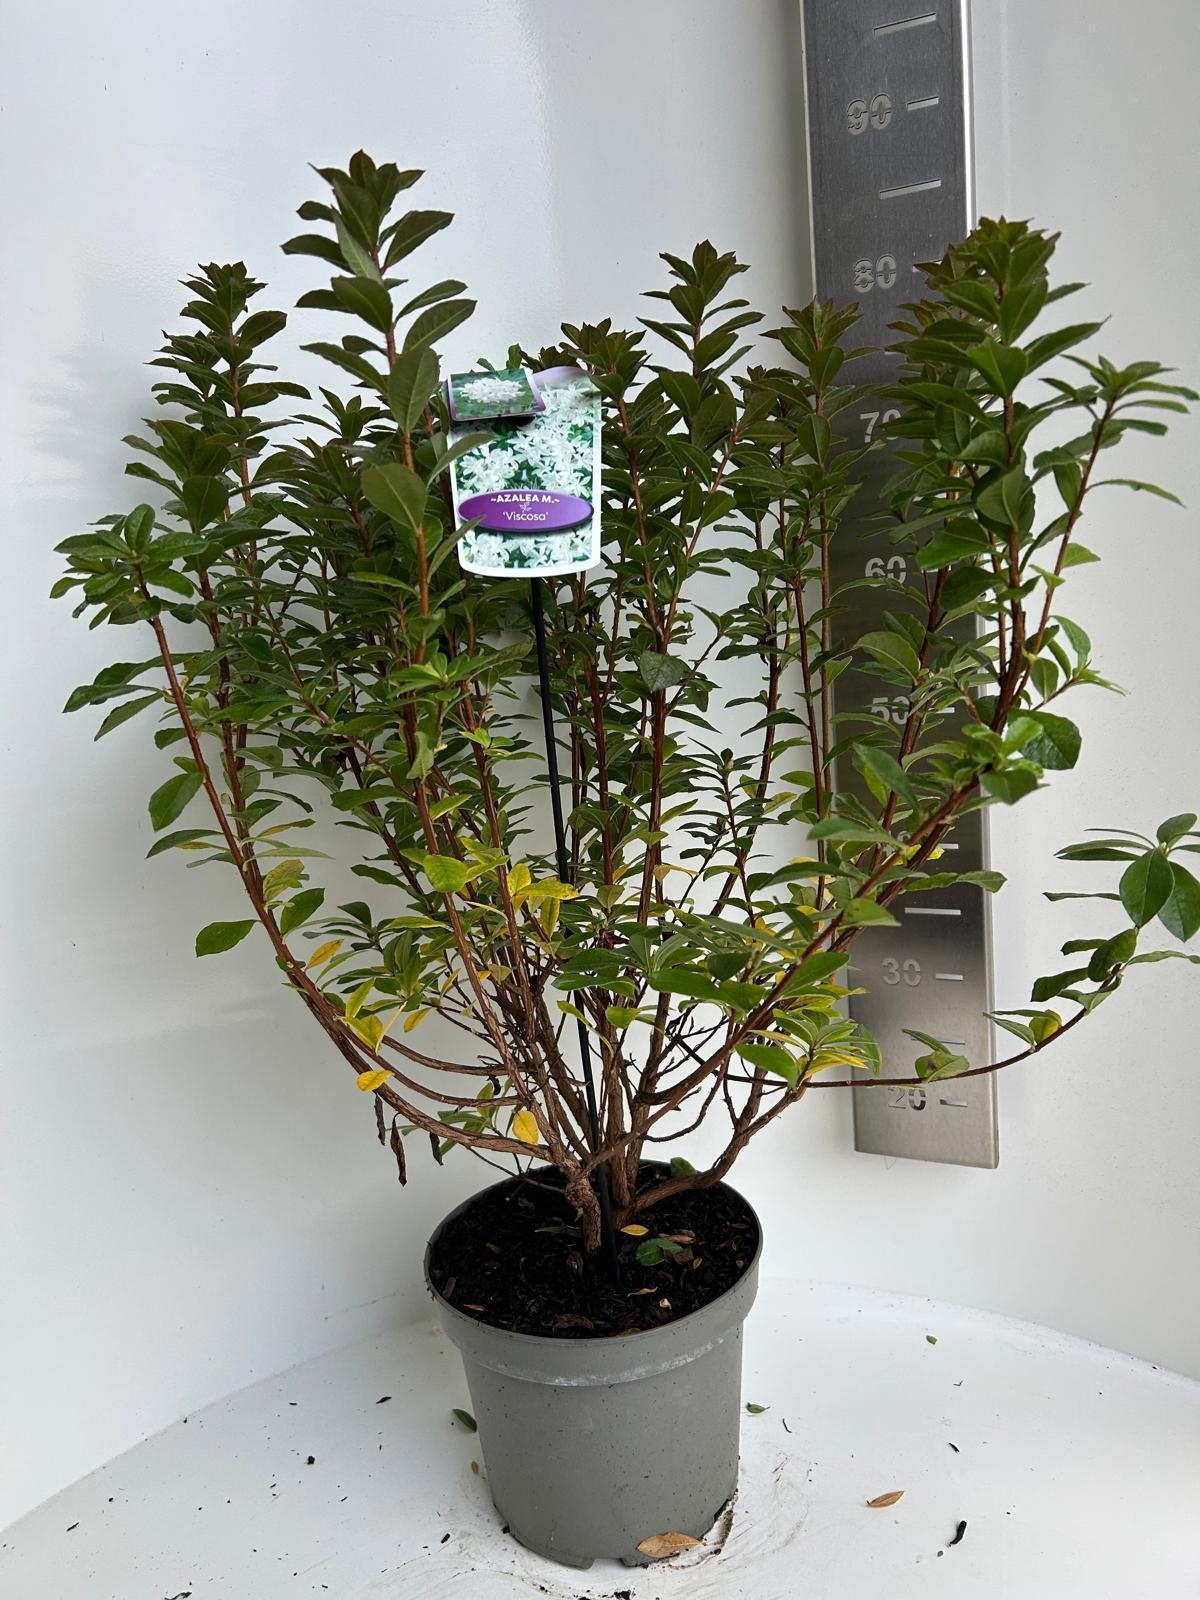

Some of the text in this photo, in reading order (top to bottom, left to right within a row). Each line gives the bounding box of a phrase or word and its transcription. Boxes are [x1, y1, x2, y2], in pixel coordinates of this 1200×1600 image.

[847, 93, 892, 135] 90
[854, 254, 896, 293] 80
[865, 556, 907, 587] 60
[881, 957, 921, 987] 30
